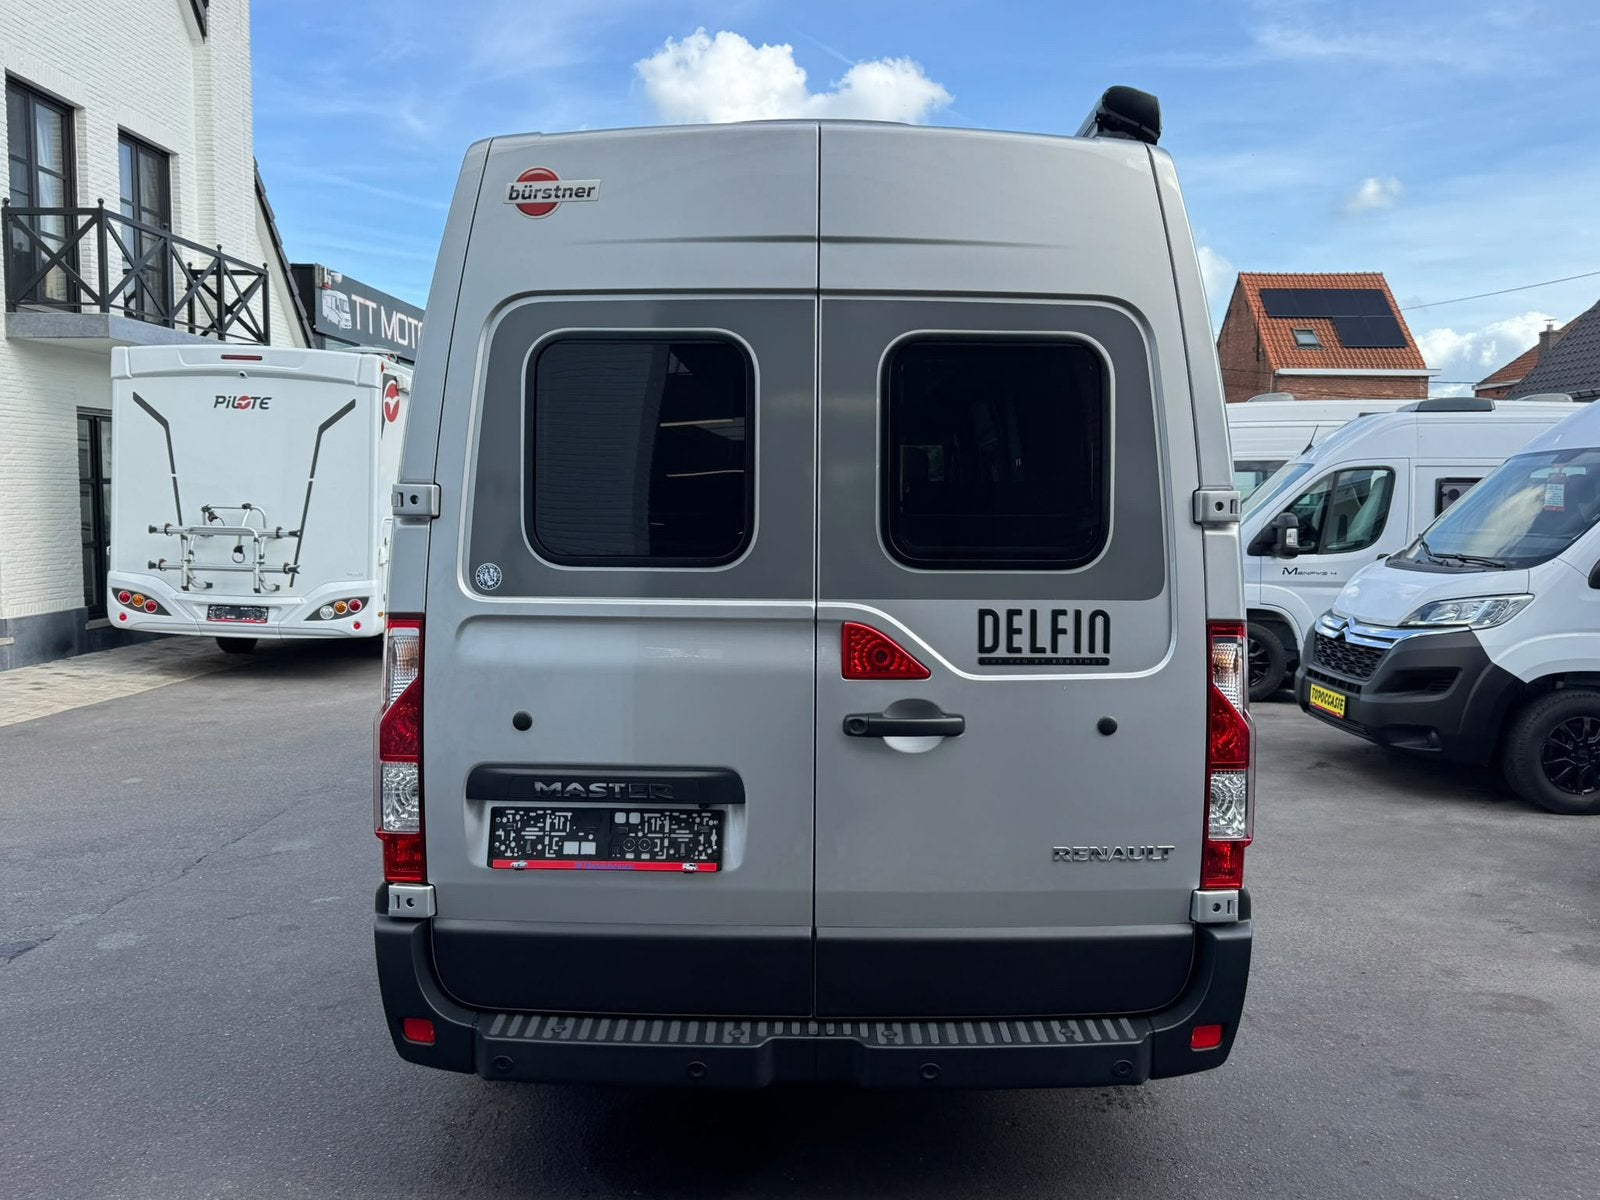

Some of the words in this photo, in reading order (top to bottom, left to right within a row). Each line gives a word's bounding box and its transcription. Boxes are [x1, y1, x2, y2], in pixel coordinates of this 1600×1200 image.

[508, 185, 595, 200] bürstner
[351, 294, 377, 335] TT
[978, 609, 1110, 654] DELFIN
[534, 781, 674, 799] MASTER
[1052, 845, 1176, 862] RENAULT
